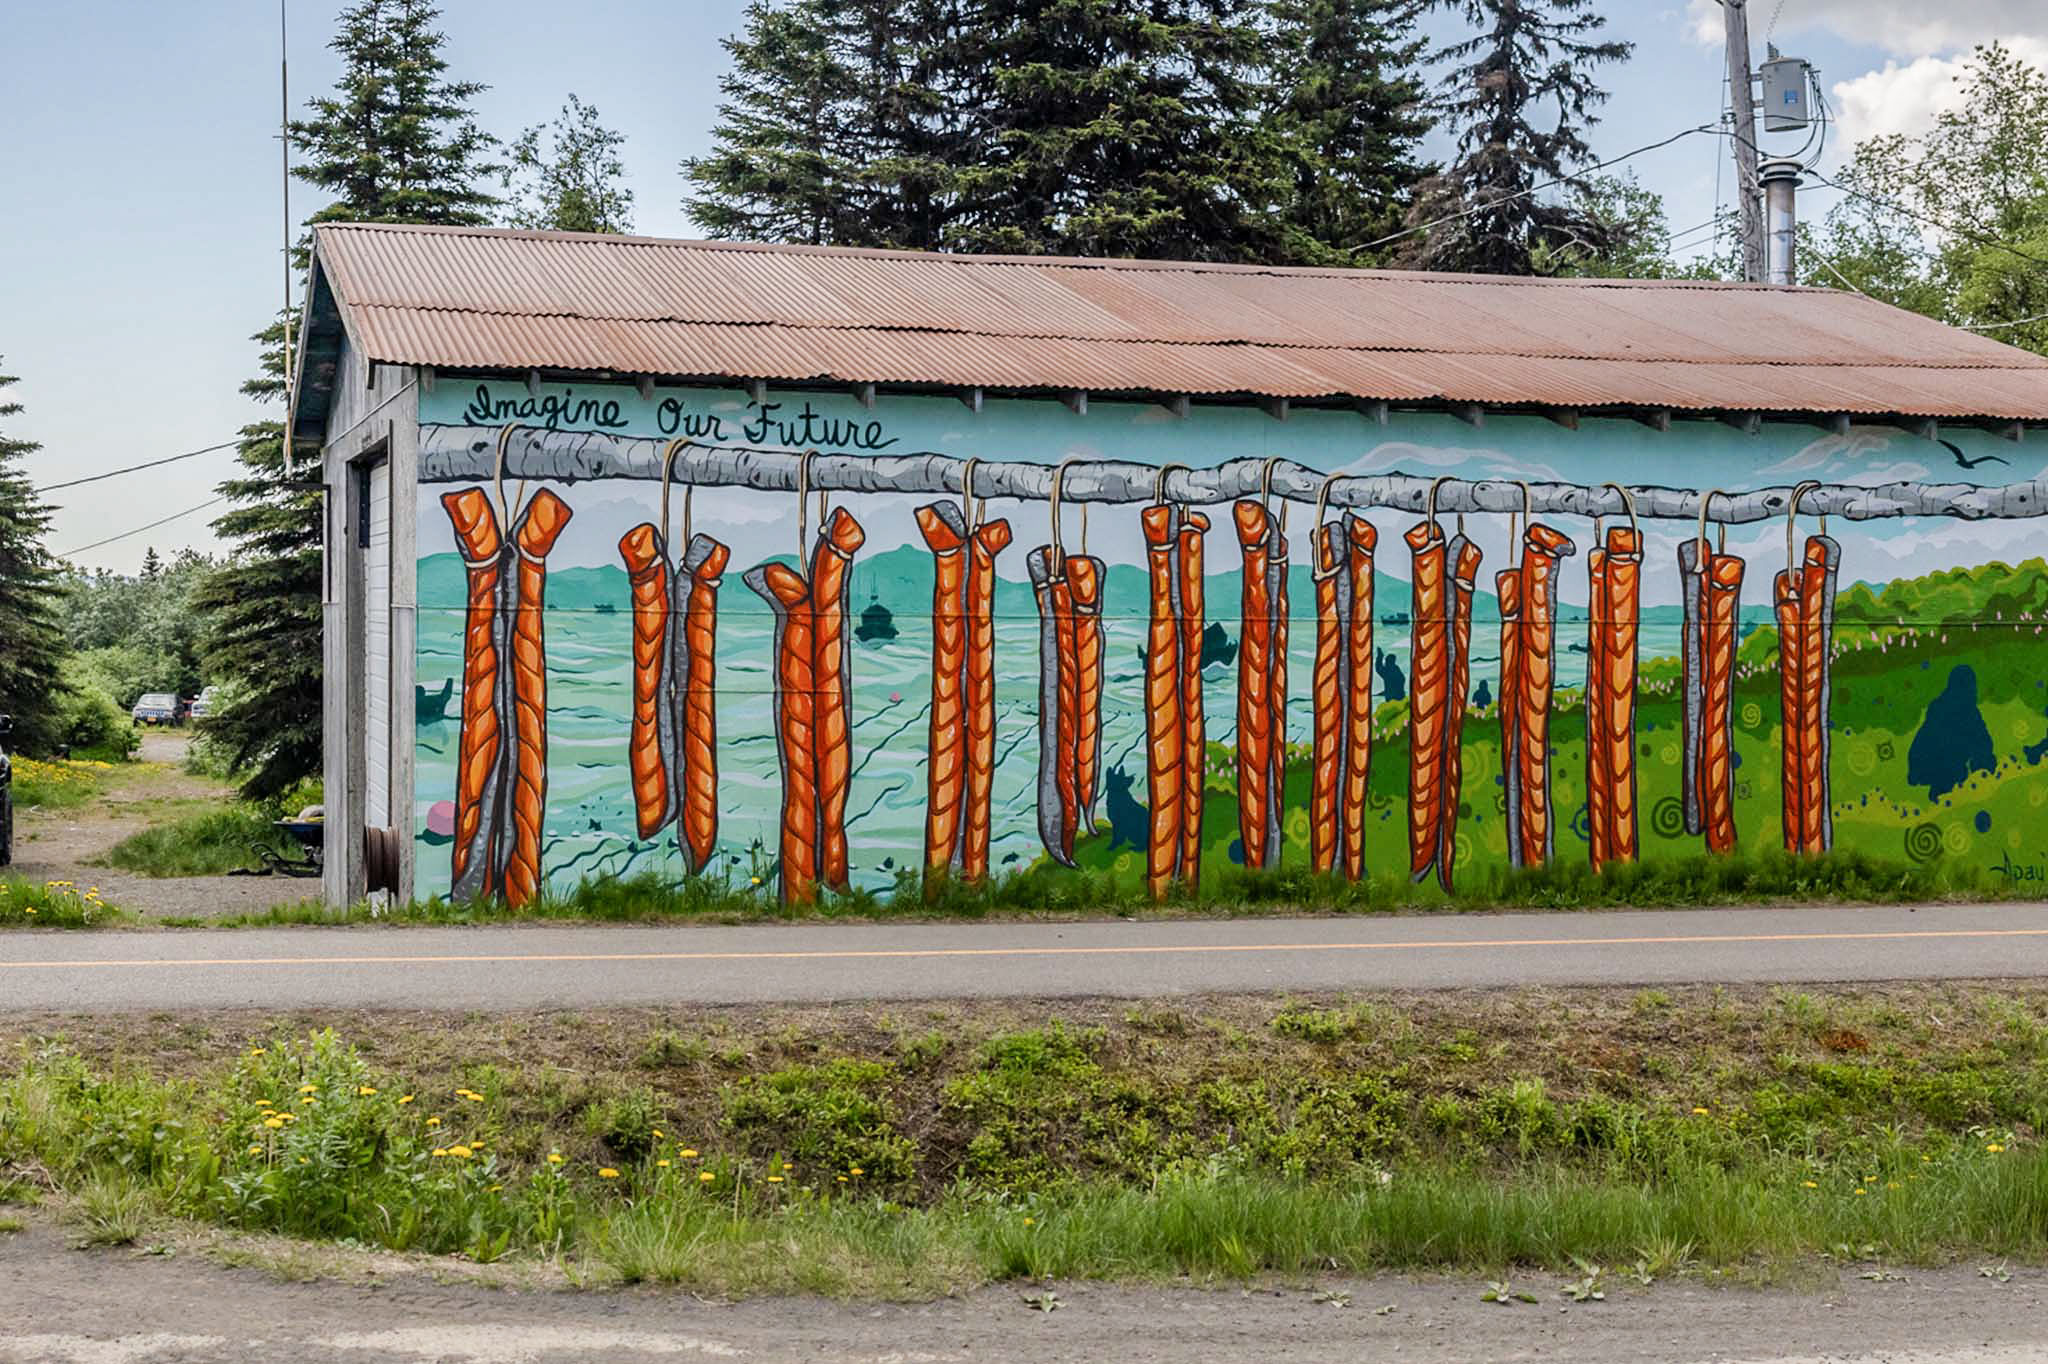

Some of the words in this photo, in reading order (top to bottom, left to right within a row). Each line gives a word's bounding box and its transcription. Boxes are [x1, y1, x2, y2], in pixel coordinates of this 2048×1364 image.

[465, 384, 628, 430] Imagine
[657, 398, 728, 441] Our
[744, 401, 899, 449] Future
